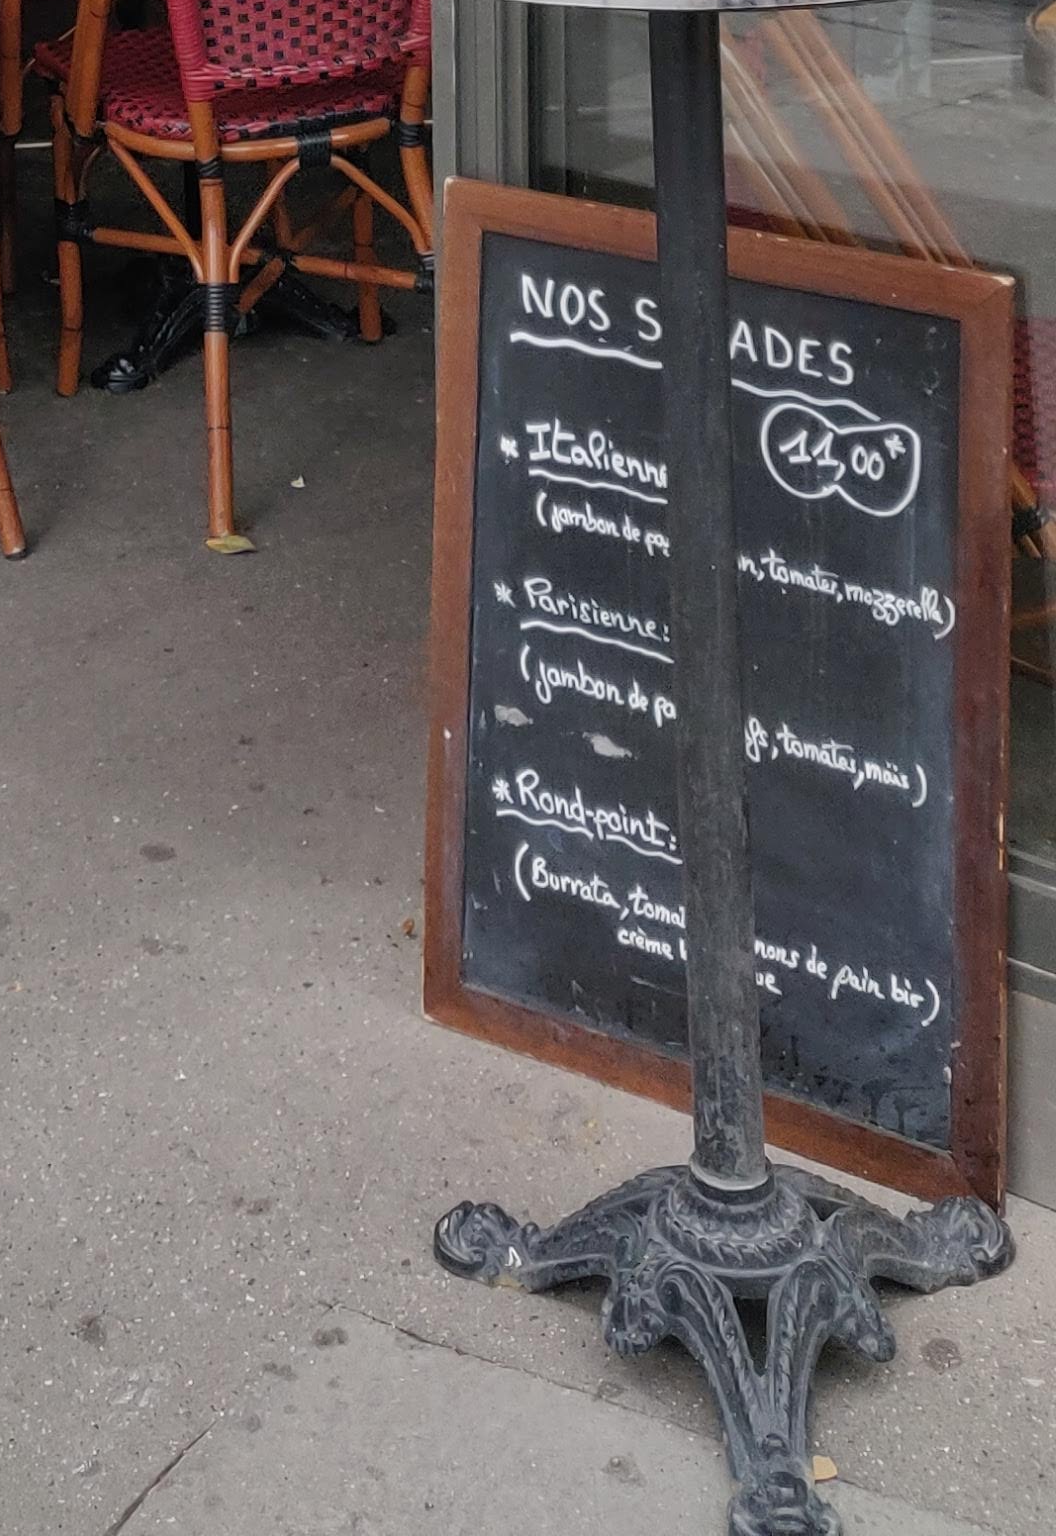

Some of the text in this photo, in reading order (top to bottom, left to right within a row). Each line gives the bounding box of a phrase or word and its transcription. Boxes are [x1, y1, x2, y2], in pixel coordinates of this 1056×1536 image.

[521, 273, 854, 386] NOS SADES
[622, 513, 641, 542] de
[628, 678, 649, 711] de
[806, 942, 828, 980] de
